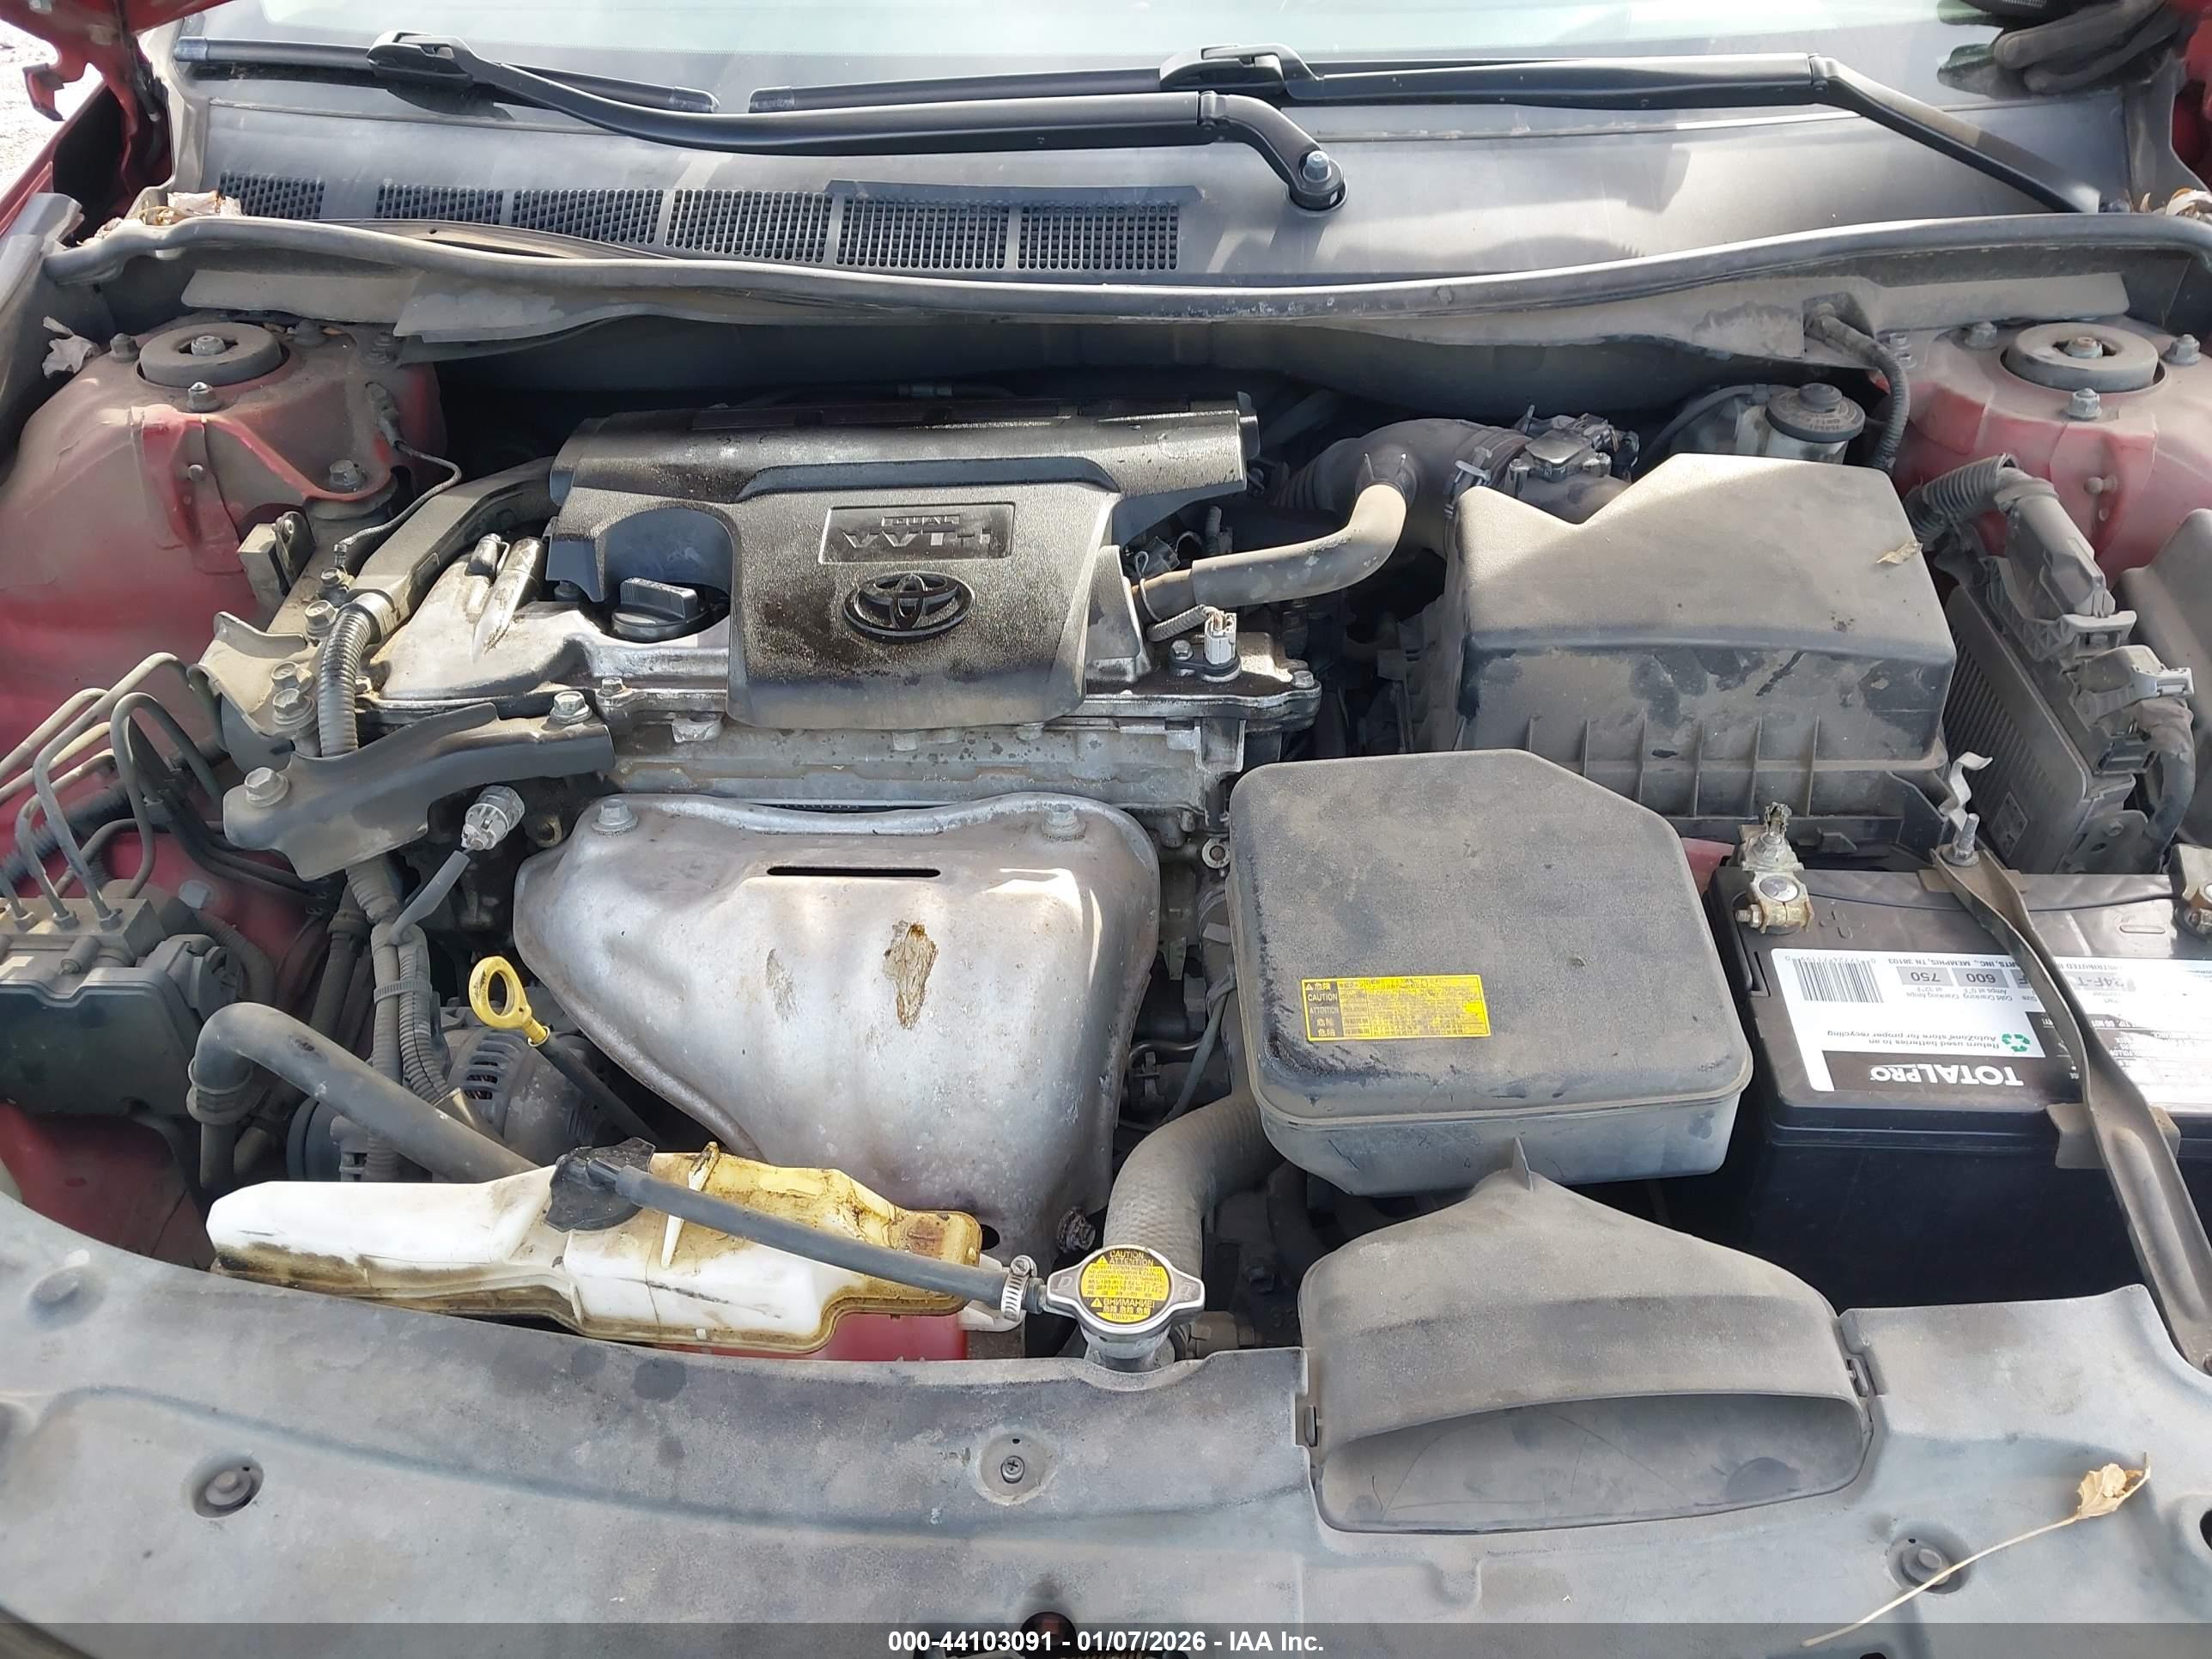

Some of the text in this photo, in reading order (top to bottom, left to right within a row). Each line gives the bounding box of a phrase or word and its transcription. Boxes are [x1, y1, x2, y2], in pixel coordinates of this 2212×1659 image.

[1910, 971, 1941, 982] 750
[1966, 973, 1996, 983] 600
[1308, 993, 1338, 1002] CAUTION
[1869, 1063, 2024, 1086] TOTALPRO
[1109, 1250, 1144, 1259] CAUTION
[1109, 1257, 1154, 1267] ATTENTION
[1103, 1297, 1155, 1309] ВНИМАНИЕ!
